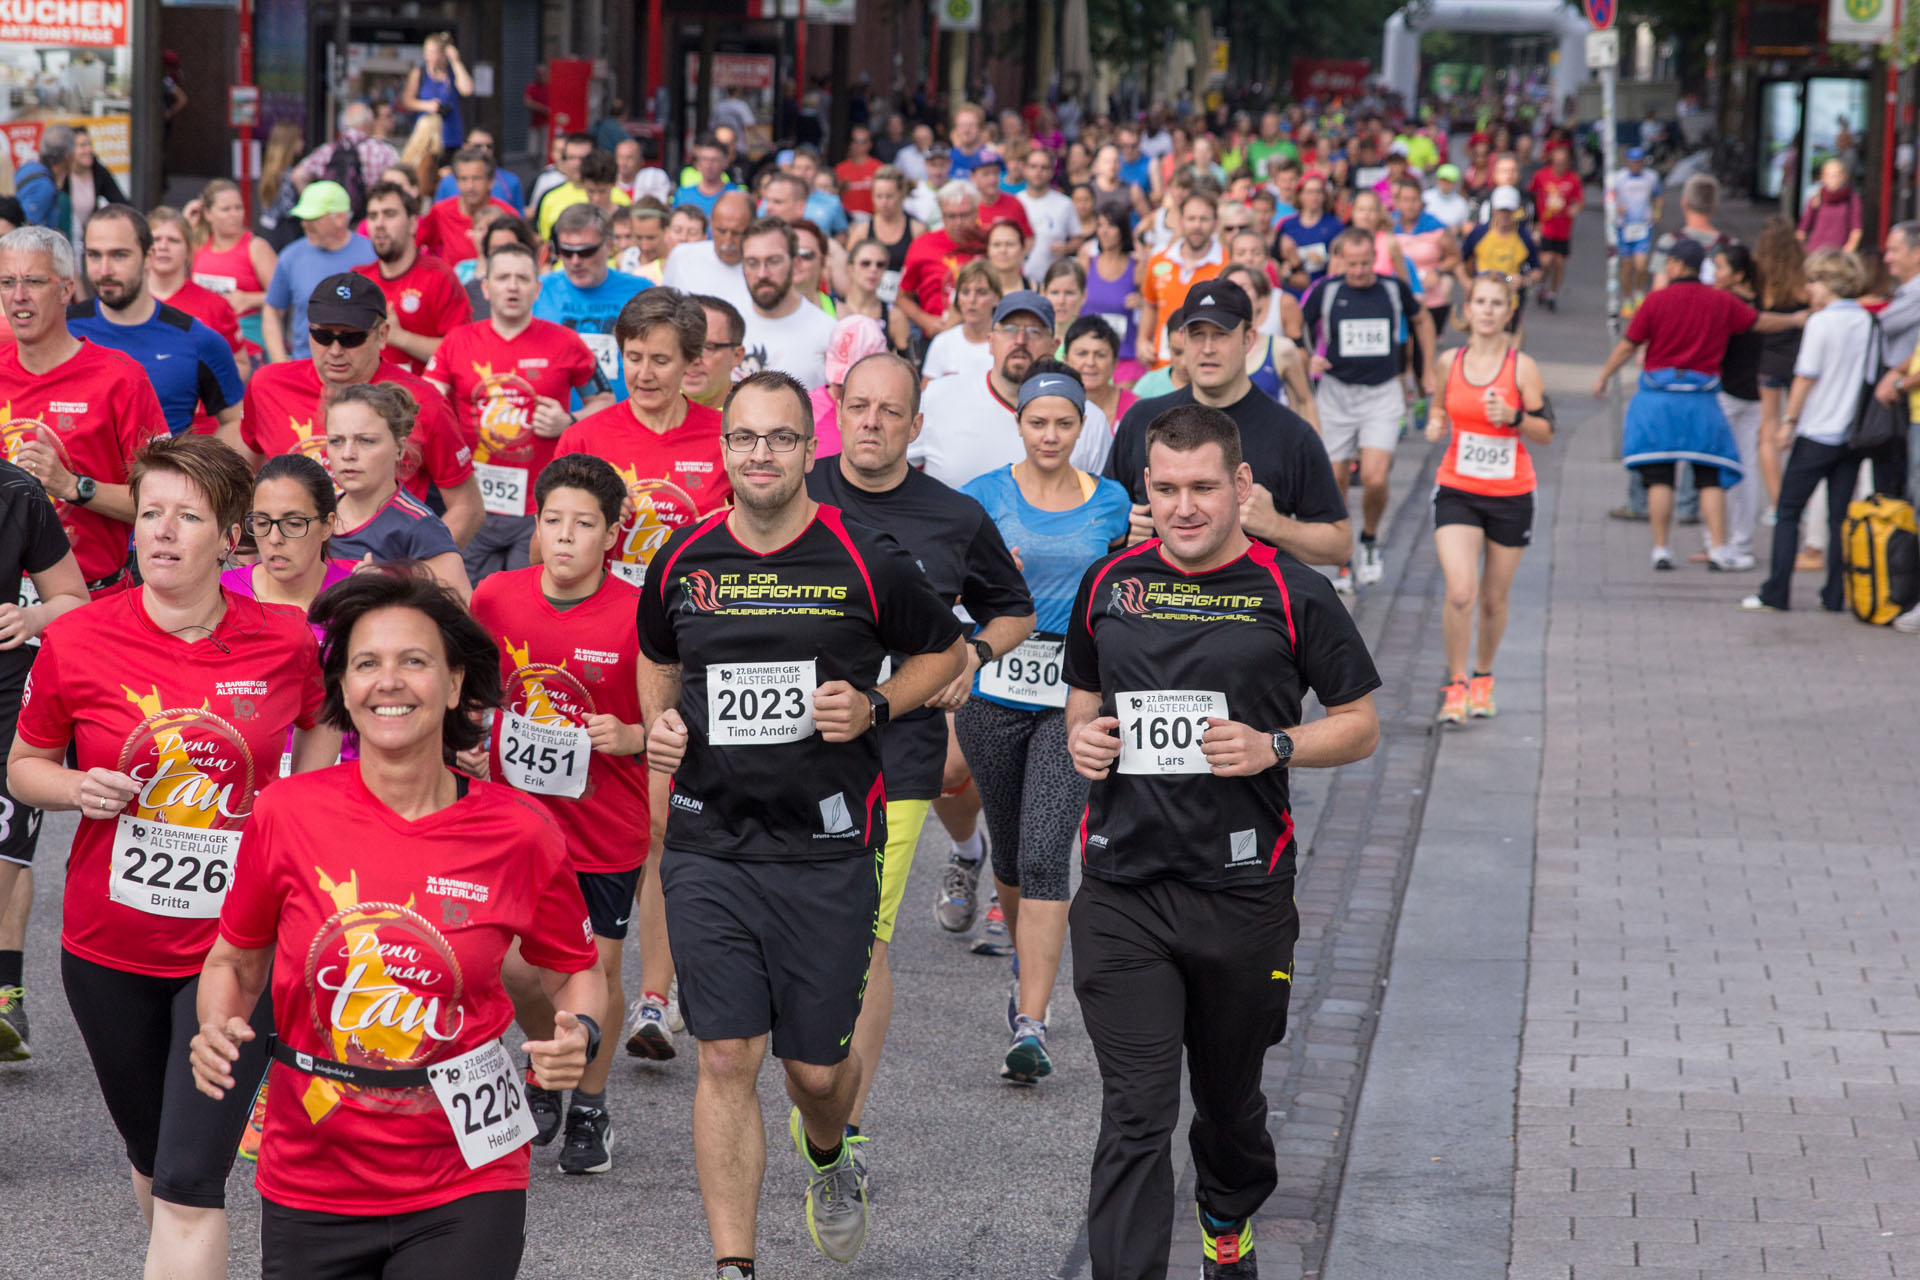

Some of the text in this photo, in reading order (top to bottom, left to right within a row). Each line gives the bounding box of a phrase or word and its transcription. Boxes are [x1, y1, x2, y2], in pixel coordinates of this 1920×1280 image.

[1, 25, 113, 44] AKTIONSTAGE
[1464, 443, 1511, 466] 2095
[620, 513, 672, 555] ta
[720, 573, 778, 585] FIT FOR
[718, 585, 847, 600] FIREFIGHTING
[1149, 582, 1201, 594] FIT FOR
[1145, 592, 1264, 608] FIREFIGHTING
[573, 653, 619, 665] ALSTERLAUF
[747, 666, 782, 675] BARMER
[782, 665, 801, 674] GEK
[225, 680, 256, 688] BARMER
[736, 674, 801, 686] ALSTERLAUF
[216, 687, 269, 696] ALSTERLAUF
[520, 681, 572, 703] Denn
[1157, 694, 1194, 703] BARMER
[1195, 695, 1213, 703] GEK
[549, 700, 584, 716] man
[718, 687, 806, 721] 2023
[1147, 702, 1214, 713] ALSTERLAUF
[521, 730, 579, 747] ALSTERLAUF
[530, 725, 562, 737] BARMER
[562, 730, 579, 738] GEK
[727, 724, 798, 737] Timo André
[150, 734, 220, 755] Denn
[187, 755, 236, 772] man
[505, 736, 576, 777] 2451
[1157, 755, 1185, 766] Lars
[130, 759, 256, 818] tau
[524, 774, 545, 787] Erik
[164, 830, 208, 842] BARMER
[208, 834, 229, 844] GEK
[150, 836, 228, 855] ALSTERLAUF
[122, 847, 229, 893] 2226
[438, 877, 474, 891] BARMER
[474, 884, 489, 893] GEK
[151, 893, 190, 909] Britta
[425, 884, 489, 903] ALSTERLAUF
[338, 933, 421, 962] Denn
[383, 964, 442, 985] man
[317, 963, 464, 1040] tau
[452, 1068, 520, 1135] 2225
[488, 1124, 521, 1149] Heidrun
